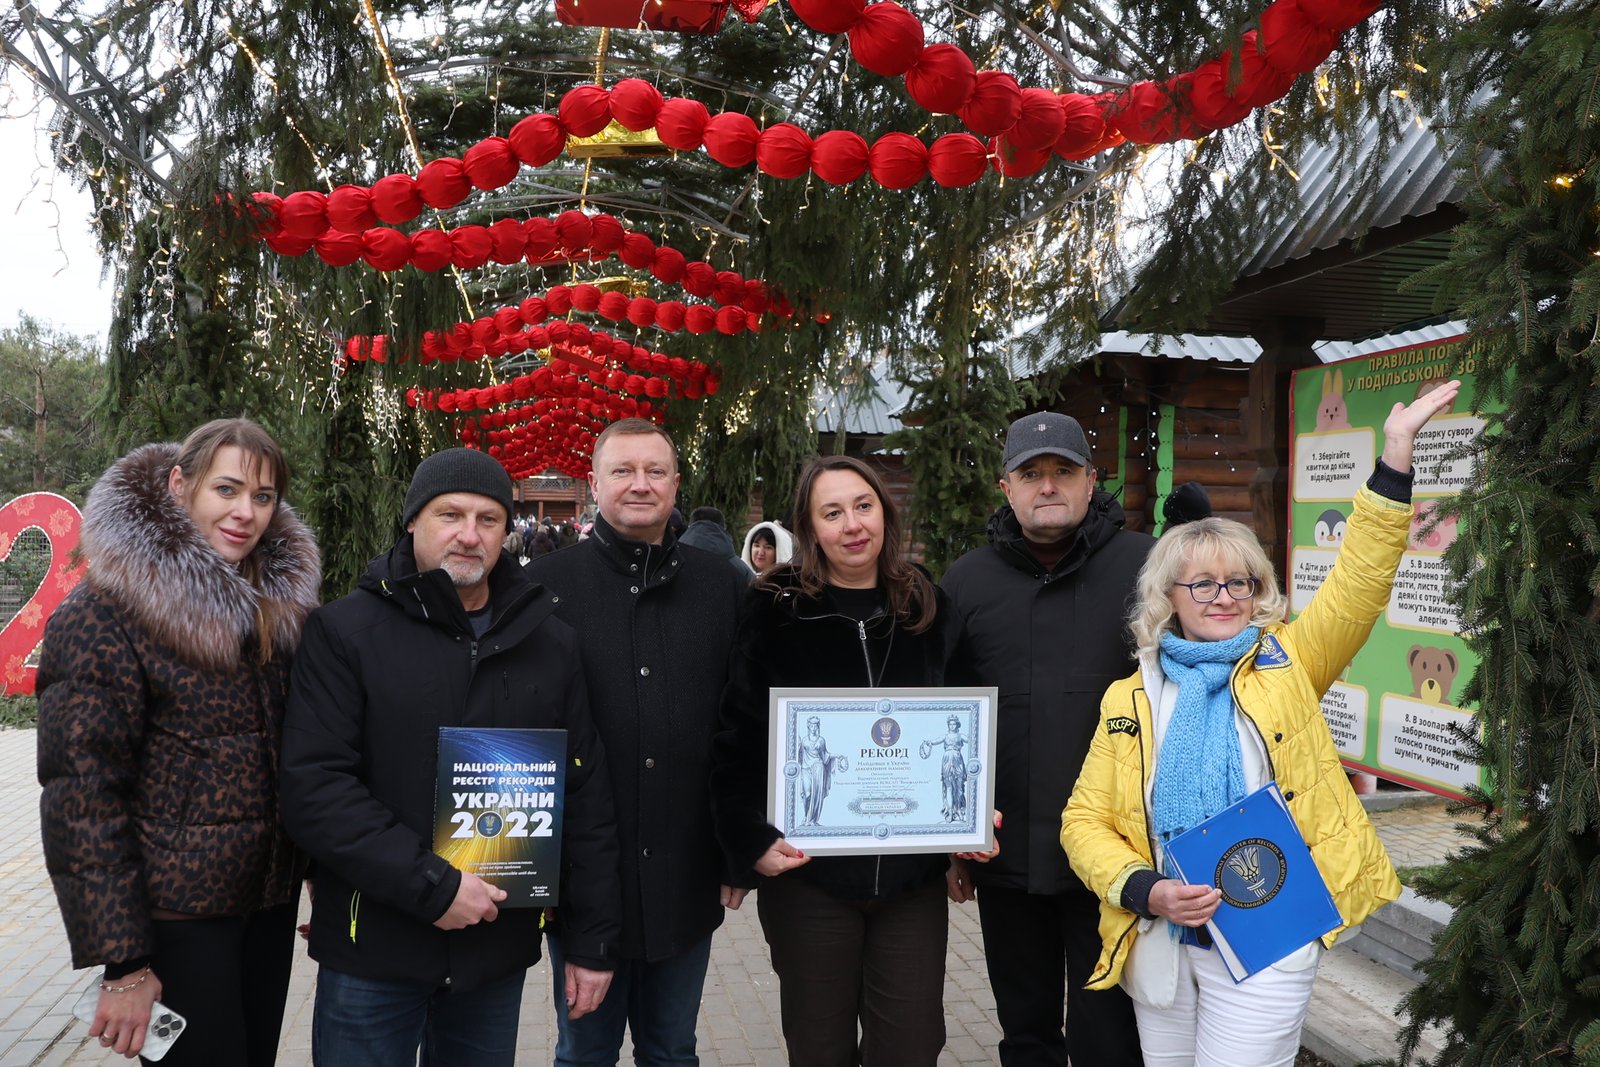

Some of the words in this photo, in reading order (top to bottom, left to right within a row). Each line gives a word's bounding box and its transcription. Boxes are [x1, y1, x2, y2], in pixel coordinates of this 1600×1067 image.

[1368, 353, 1425, 371] ПРАВИЛА
[1347, 379, 1355, 392] У
[1415, 429, 1446, 441] оопарку
[1447, 427, 1474, 439] суворо
[1412, 440, 1463, 452] абороняється
[1318, 450, 1351, 462] Зберігайте
[1413, 454, 1437, 465] дувати
[1330, 463, 1337, 472] до
[1338, 461, 1355, 471] кінця
[1418, 466, 1427, 474] та
[1429, 464, 1453, 473] птхів
[1310, 473, 1351, 483] відвідування
[1305, 562, 1318, 572] Діти
[1319, 565, 1327, 573] до
[1410, 560, 1416, 568] 5.
[1417, 560, 1422, 568] В
[1423, 561, 1450, 572] зоопар
[1294, 572, 1306, 582] віку
[1397, 569, 1439, 581] заборонено
[1394, 580, 1416, 591] квіти,
[1417, 582, 1440, 592] листя,
[1398, 591, 1417, 602] деякі
[1419, 593, 1423, 601] є
[1398, 602, 1427, 613] можуть
[1418, 615, 1448, 626] алергію
[1327, 690, 1346, 702] парку
[1330, 709, 1357, 723] огорожі,
[1405, 713, 1412, 723] 8.
[1412, 715, 1418, 724] В
[1418, 718, 1453, 734] зоопарк
[1394, 735, 1423, 749] голосно
[1401, 725, 1457, 747] забороняється
[860, 748, 909, 759] РЕКОРД
[1394, 748, 1425, 763] шуміти,
[1426, 756, 1460, 772] кричати
[453, 760, 557, 773] НАЦІОНАЛЬНИЙ
[452, 776, 496, 786] РЕЄСТР
[498, 776, 556, 787] РЕКОРДІВ
[452, 787, 555, 808] УКРАЇНИ
[1257, 840, 1280, 854] RECORDS
[1222, 893, 1263, 908] АЦІОНАЛЬНИЙ
